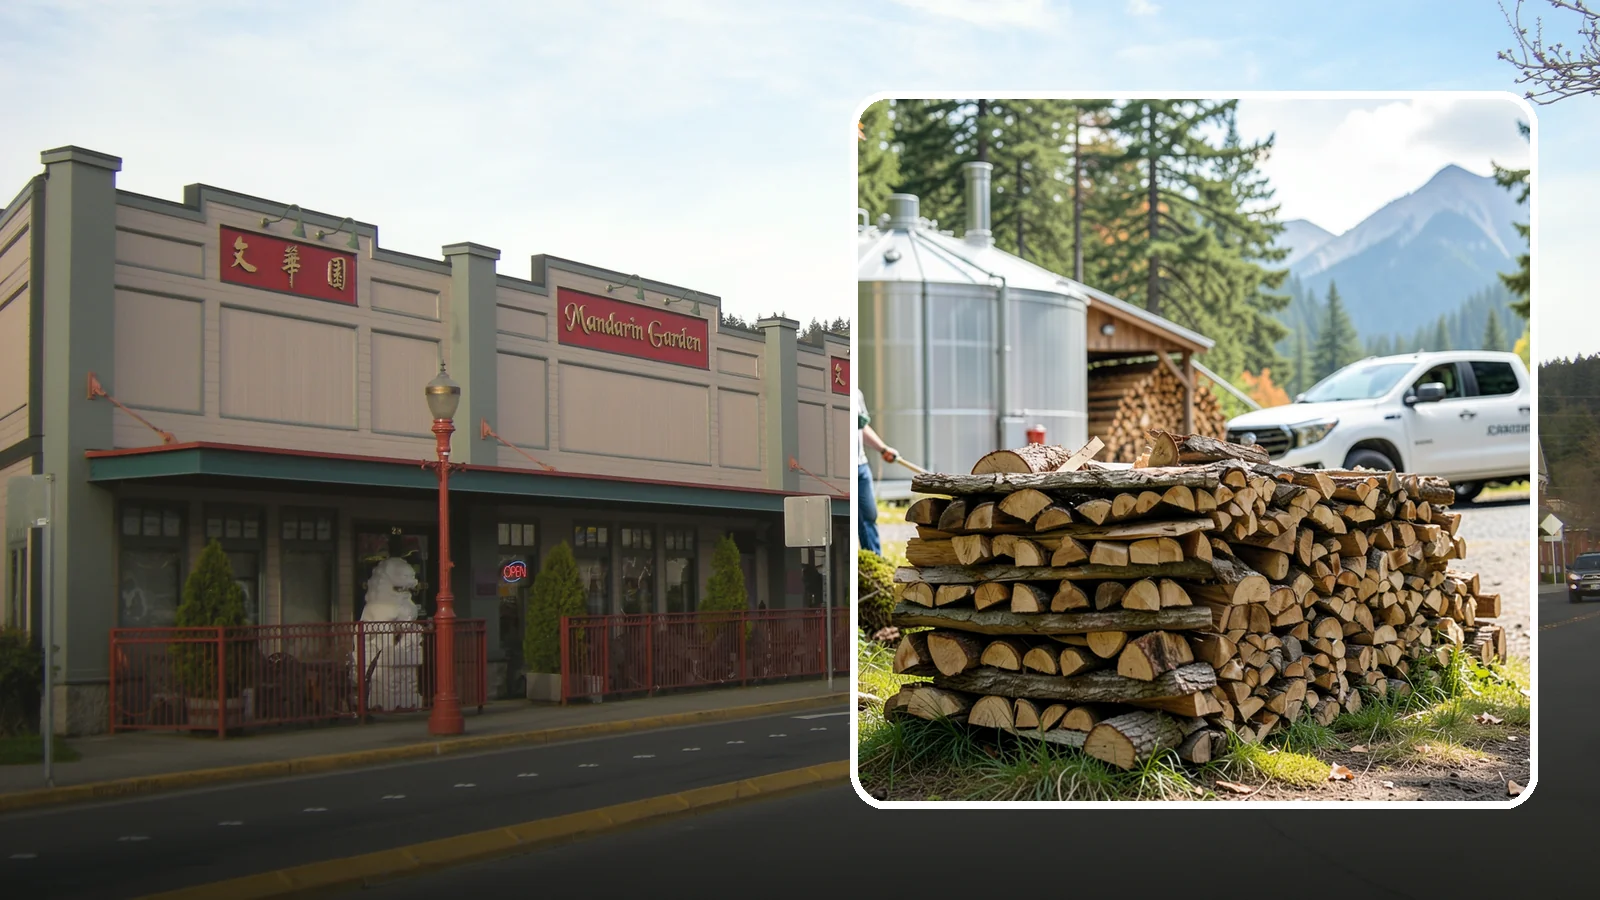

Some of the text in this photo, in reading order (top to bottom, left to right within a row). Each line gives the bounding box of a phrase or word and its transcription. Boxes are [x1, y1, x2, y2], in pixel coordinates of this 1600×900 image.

[231, 235, 346, 291] 文華園
[564, 302, 701, 352] Mandarin Garden
[503, 565, 527, 578] OPEN
